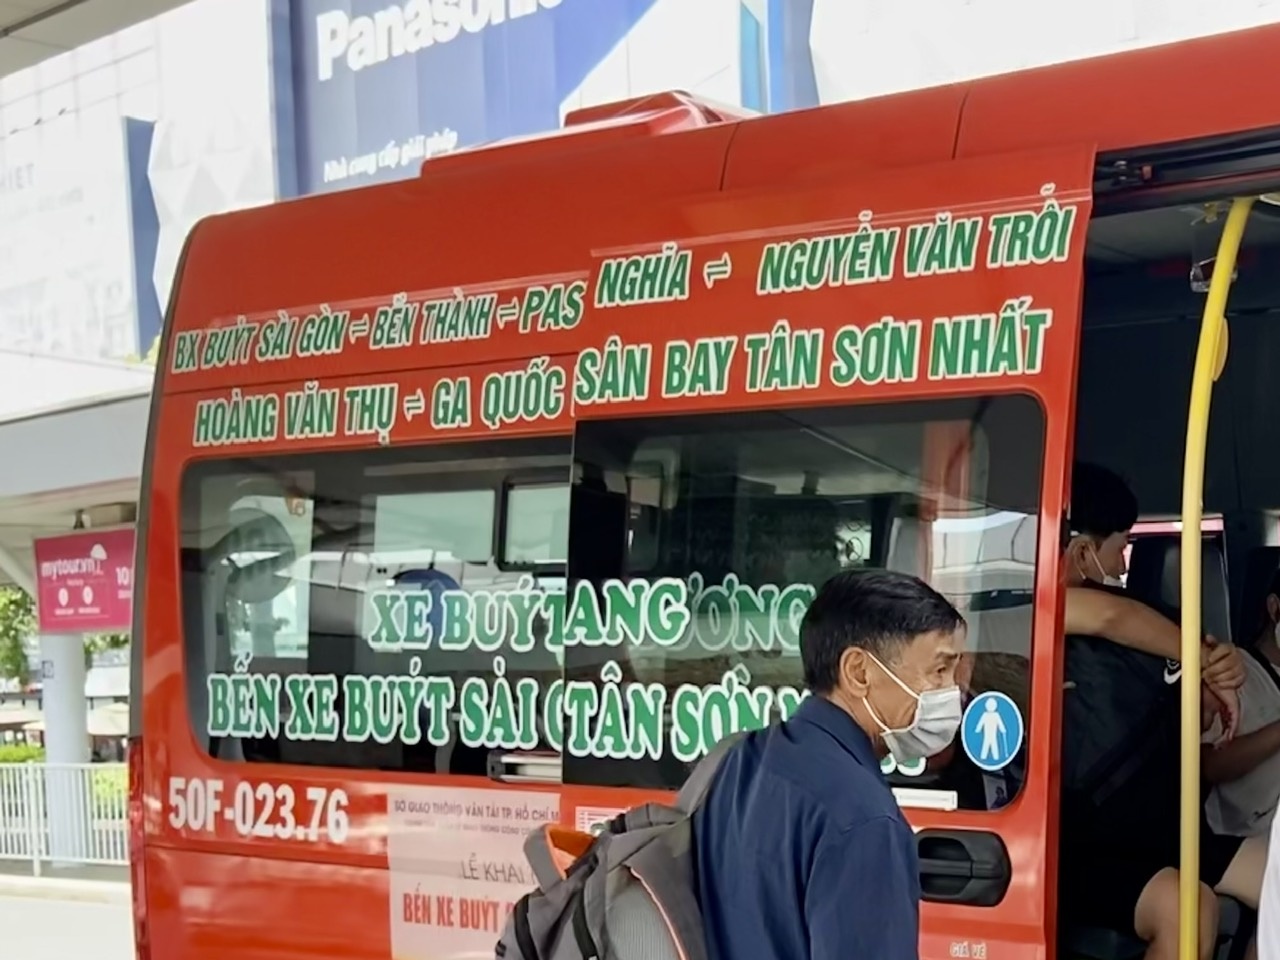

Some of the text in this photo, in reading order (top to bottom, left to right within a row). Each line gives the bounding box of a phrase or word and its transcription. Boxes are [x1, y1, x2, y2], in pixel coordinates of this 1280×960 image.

[594, 241, 693, 308] NGHĨA
[756, 183, 1078, 296] NGUYỄN VĂN TRỖI
[172, 281, 587, 374] BX BUÝT SÀI GÒN BẾN THÀNH PAS
[573, 295, 1053, 403] SÂN BAY TÂN SƠN NHẤT
[193, 356, 565, 447] HOÀNG VĂN THỤ GA QUỐC
[368, 590, 433, 650] XE
[207, 651, 282, 739] BẾN
[284, 675, 339, 741] XE
[343, 657, 455, 745] BUÝT
[459, 656, 539, 750] SÀI
[564, 660, 667, 760] TÂN
[168, 776, 350, 844] 50F-023.76
[403, 882, 431, 925] BẾN
[436, 895, 454, 928] XE
[461, 852, 480, 880] LỄ
[484, 862, 524, 885] KHAI
